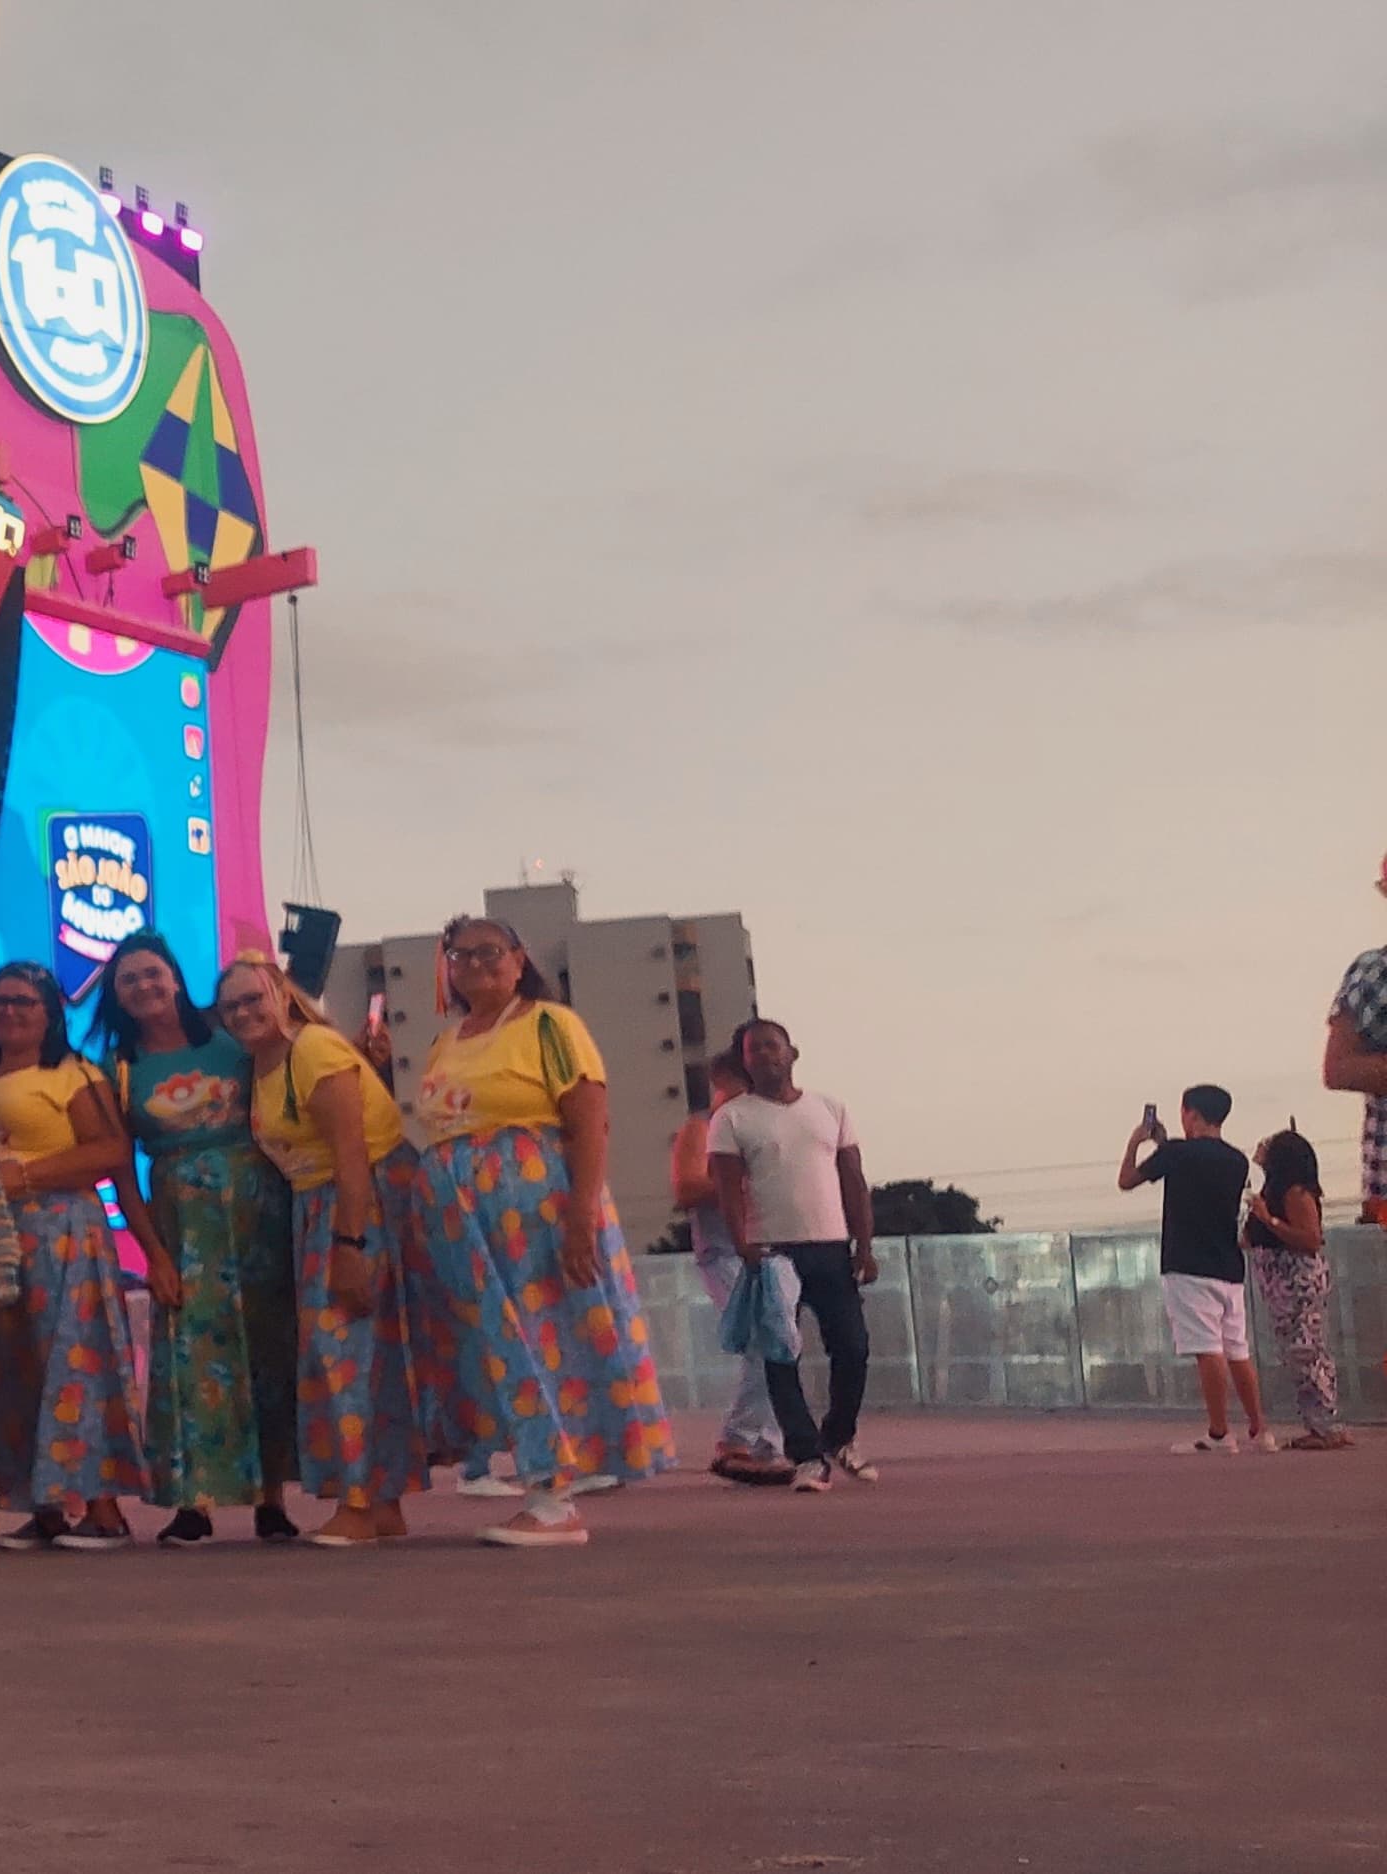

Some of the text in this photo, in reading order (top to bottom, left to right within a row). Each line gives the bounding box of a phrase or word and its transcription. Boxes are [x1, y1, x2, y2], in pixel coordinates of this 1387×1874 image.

[63, 822, 136, 866] O MAIOR
[55, 850, 148, 903] SÃO JOÃO
[61, 890, 144, 942] MUNDO
